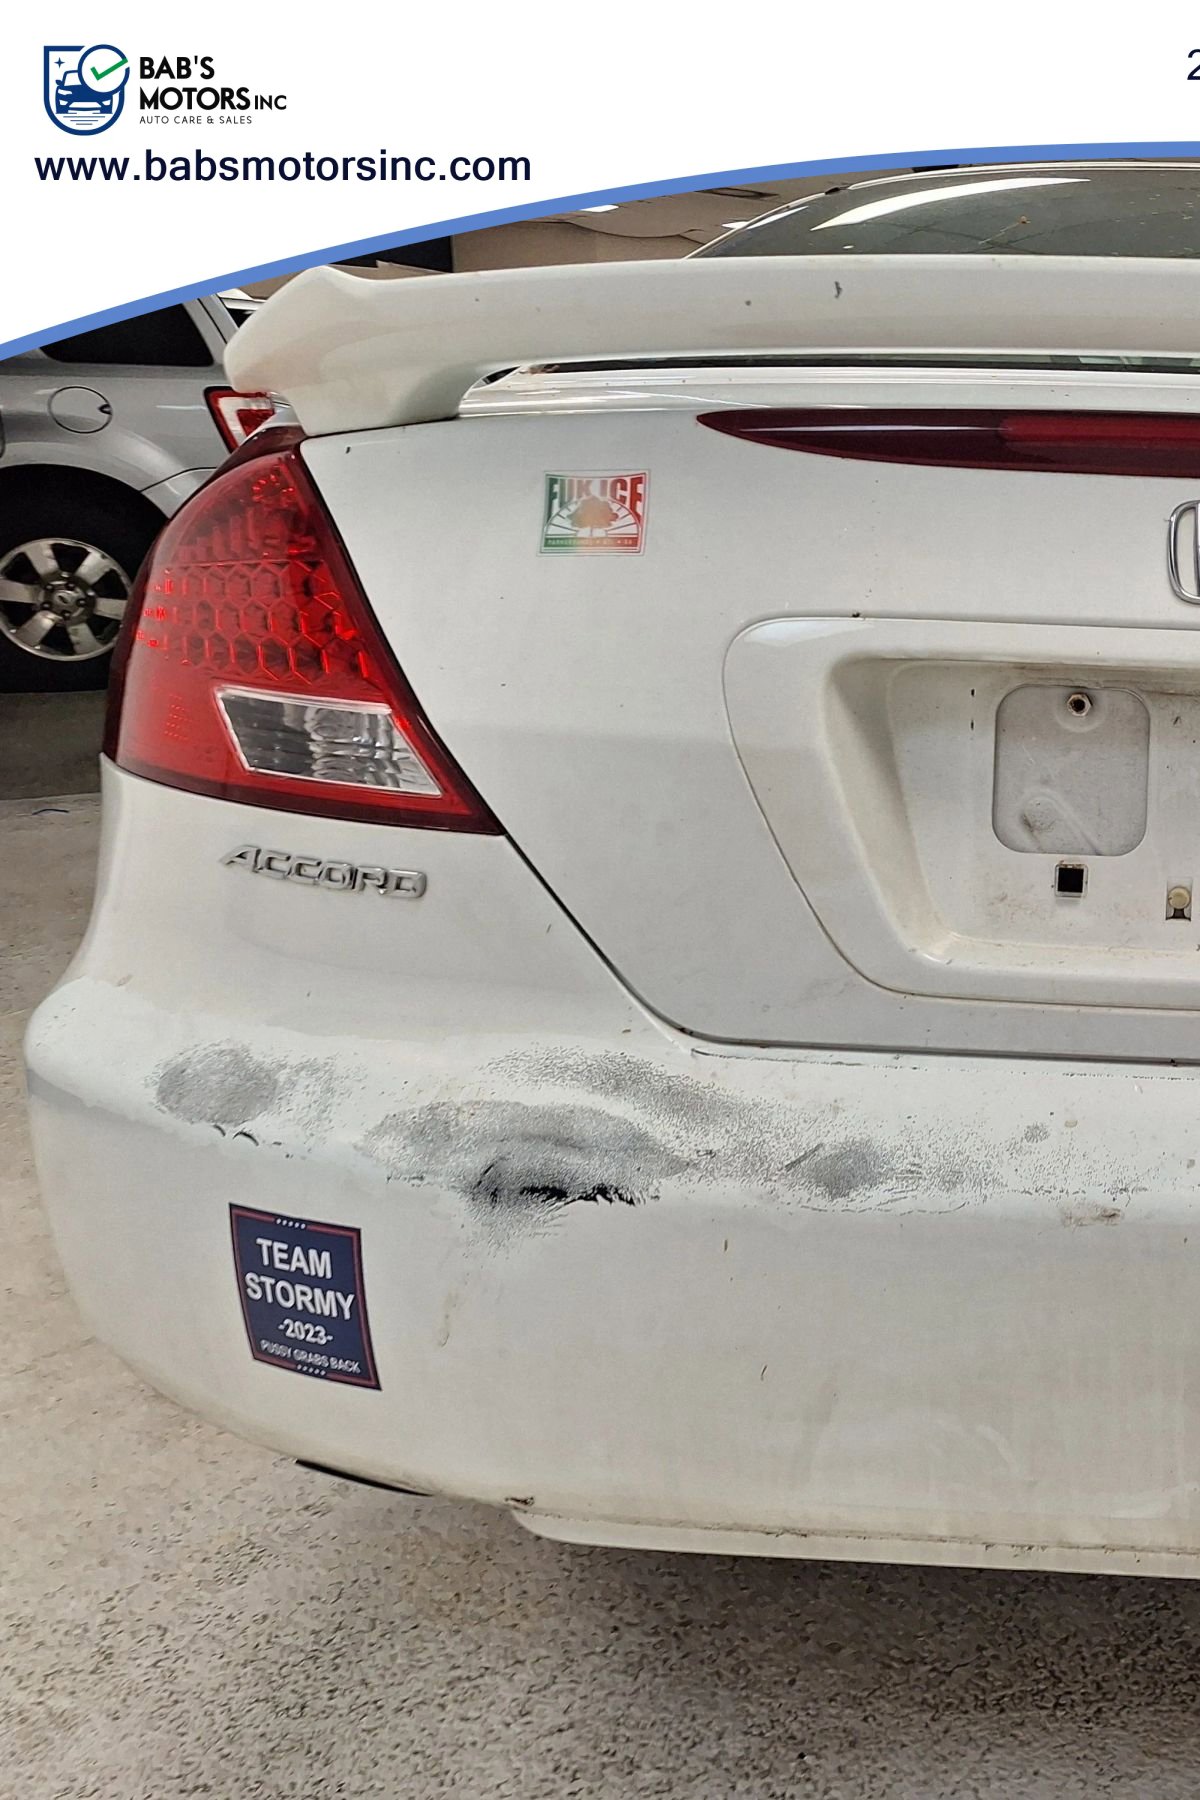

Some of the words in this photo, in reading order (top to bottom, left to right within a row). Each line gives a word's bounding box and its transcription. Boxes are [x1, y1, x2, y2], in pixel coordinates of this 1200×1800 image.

[219, 844, 428, 899] ACCORD
[256, 1237, 333, 1280] TEAM
[244, 1271, 355, 1321] STORMY
[277, 1317, 334, 1346] -2023-
[330, 1355, 362, 1374] BACK
